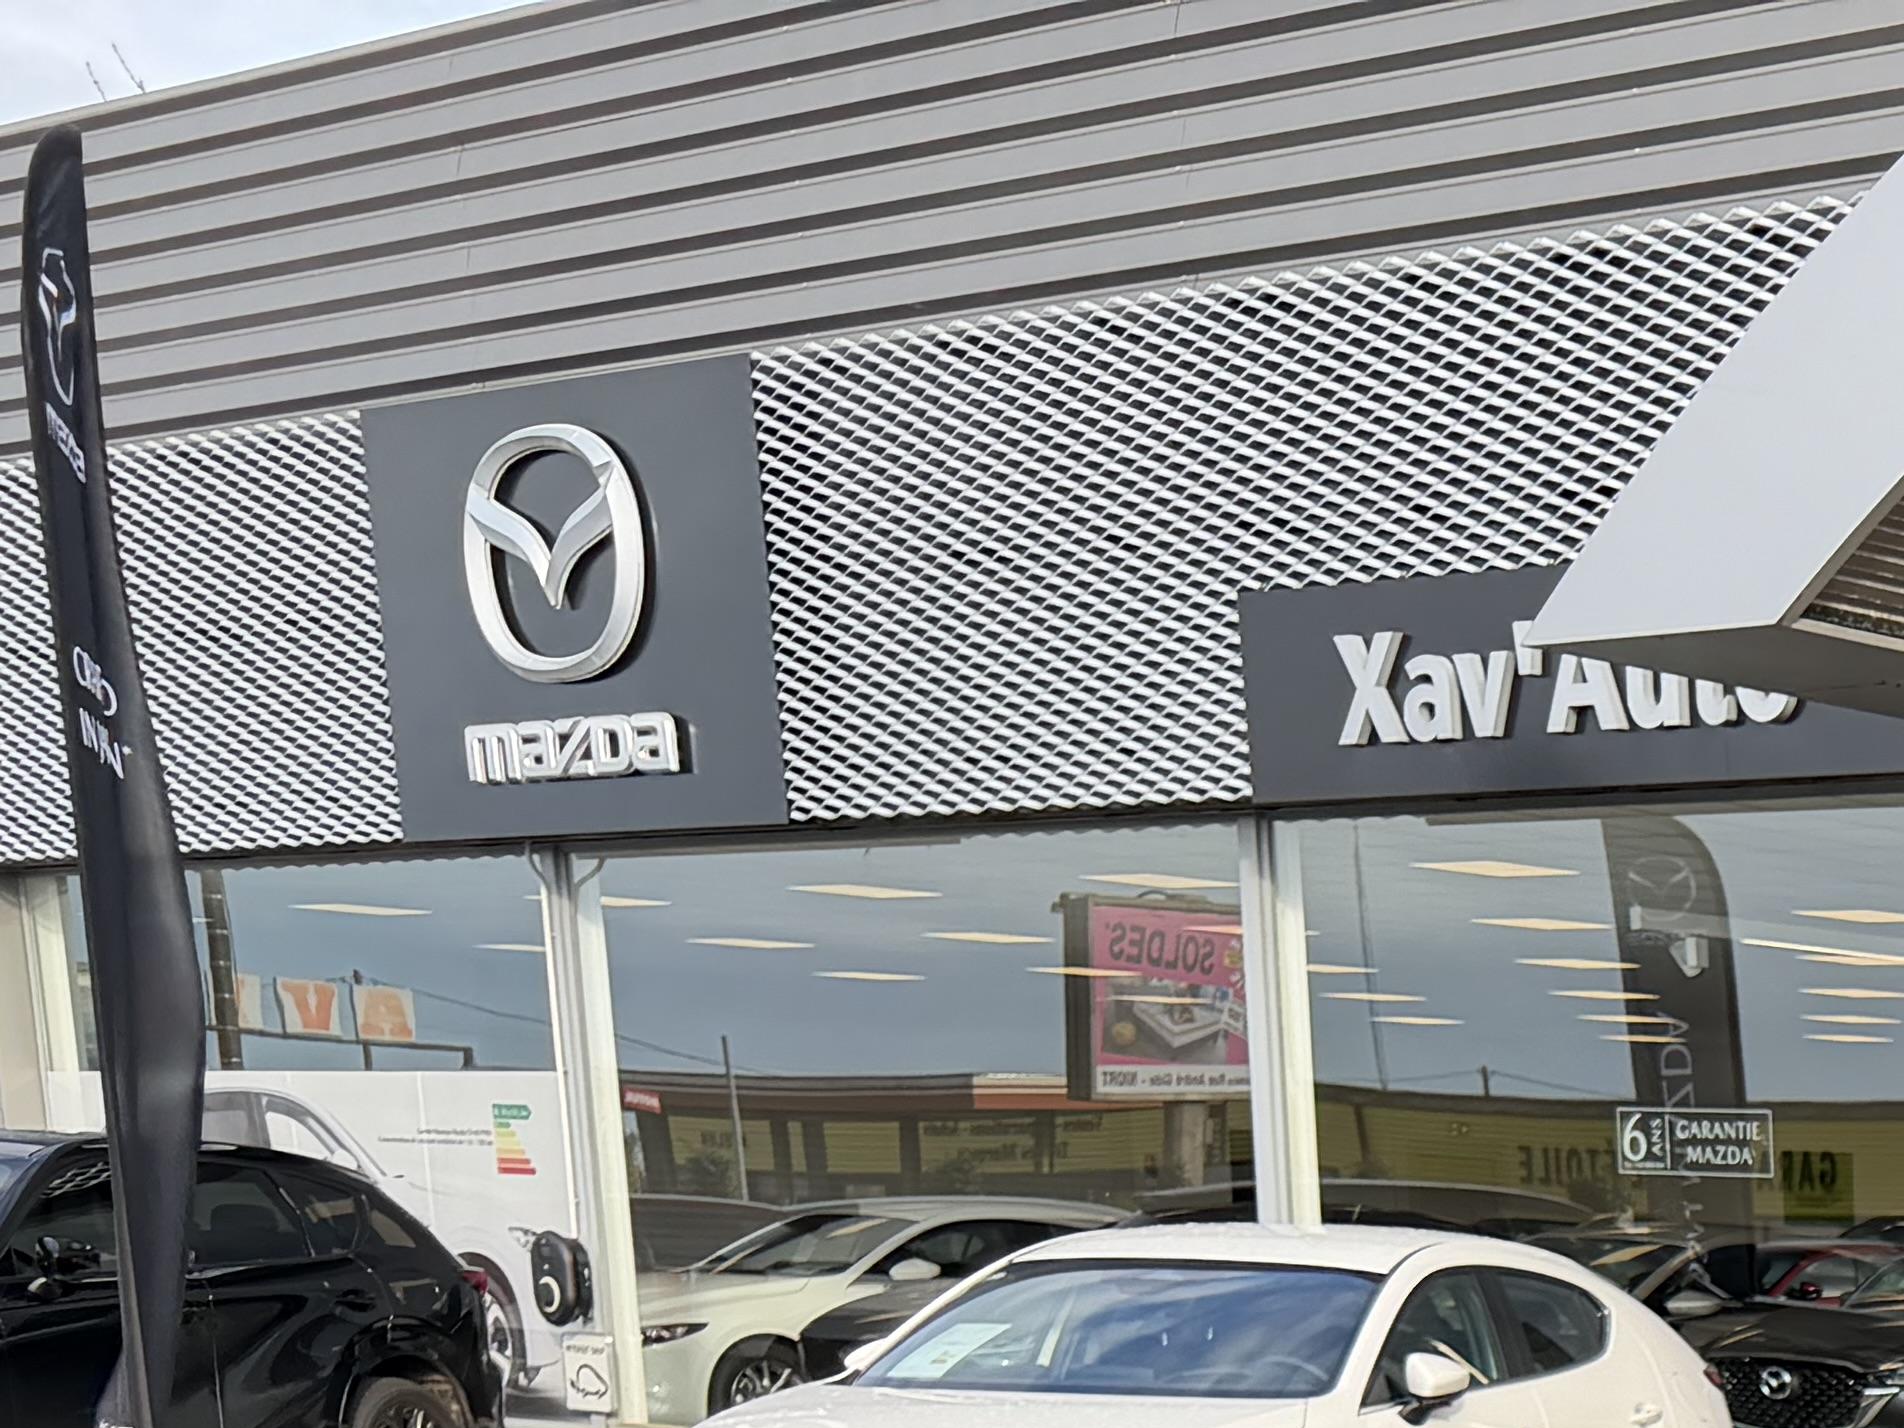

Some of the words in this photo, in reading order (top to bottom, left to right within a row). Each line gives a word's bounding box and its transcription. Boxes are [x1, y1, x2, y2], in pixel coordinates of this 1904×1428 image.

[1622, 1112, 1649, 1163] 6
[1675, 1119, 1764, 1142] GARANTIE
[1686, 1145, 1754, 1167] MAZDA
